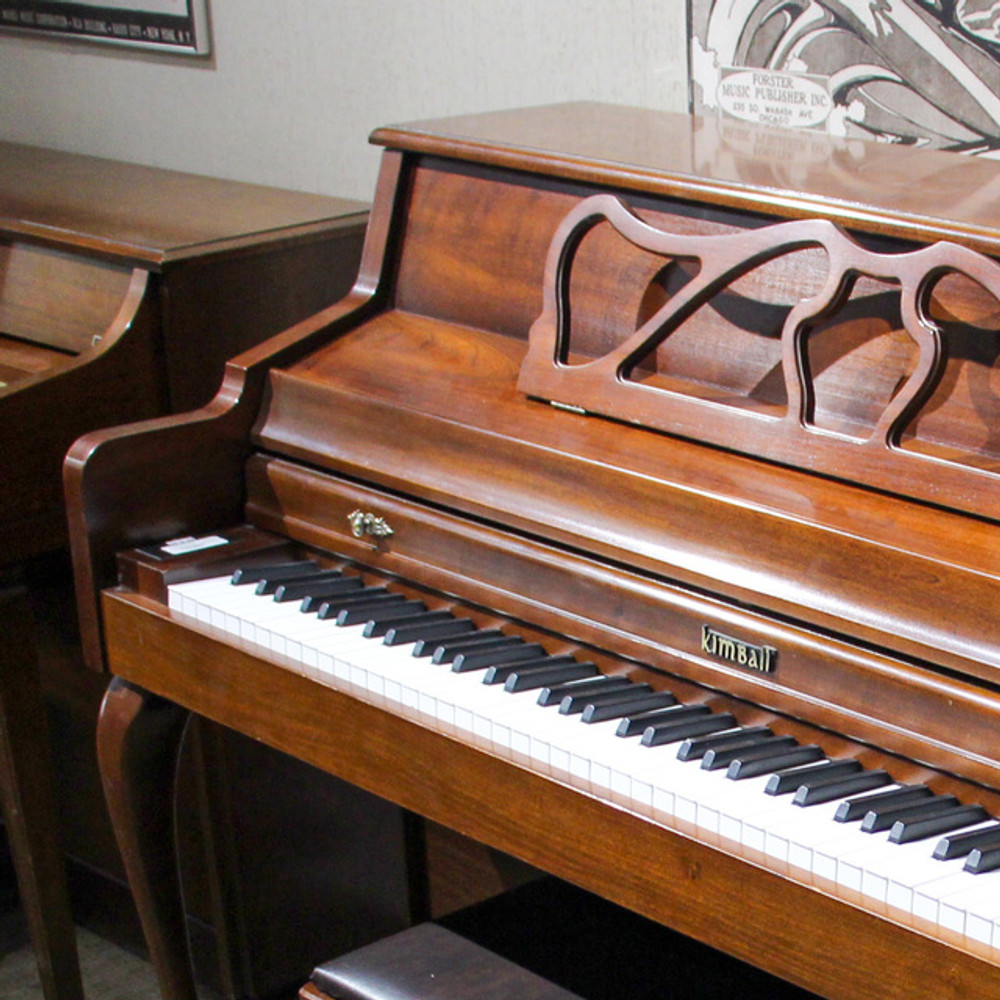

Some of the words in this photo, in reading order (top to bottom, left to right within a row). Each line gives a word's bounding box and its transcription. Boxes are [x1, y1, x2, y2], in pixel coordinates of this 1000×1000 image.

[753, 73, 794, 89] FORSTER
[722, 84, 751, 98] MUSIC
[755, 87, 808, 105] PUBLISHER
[759, 113, 790, 124] CHICAGO
